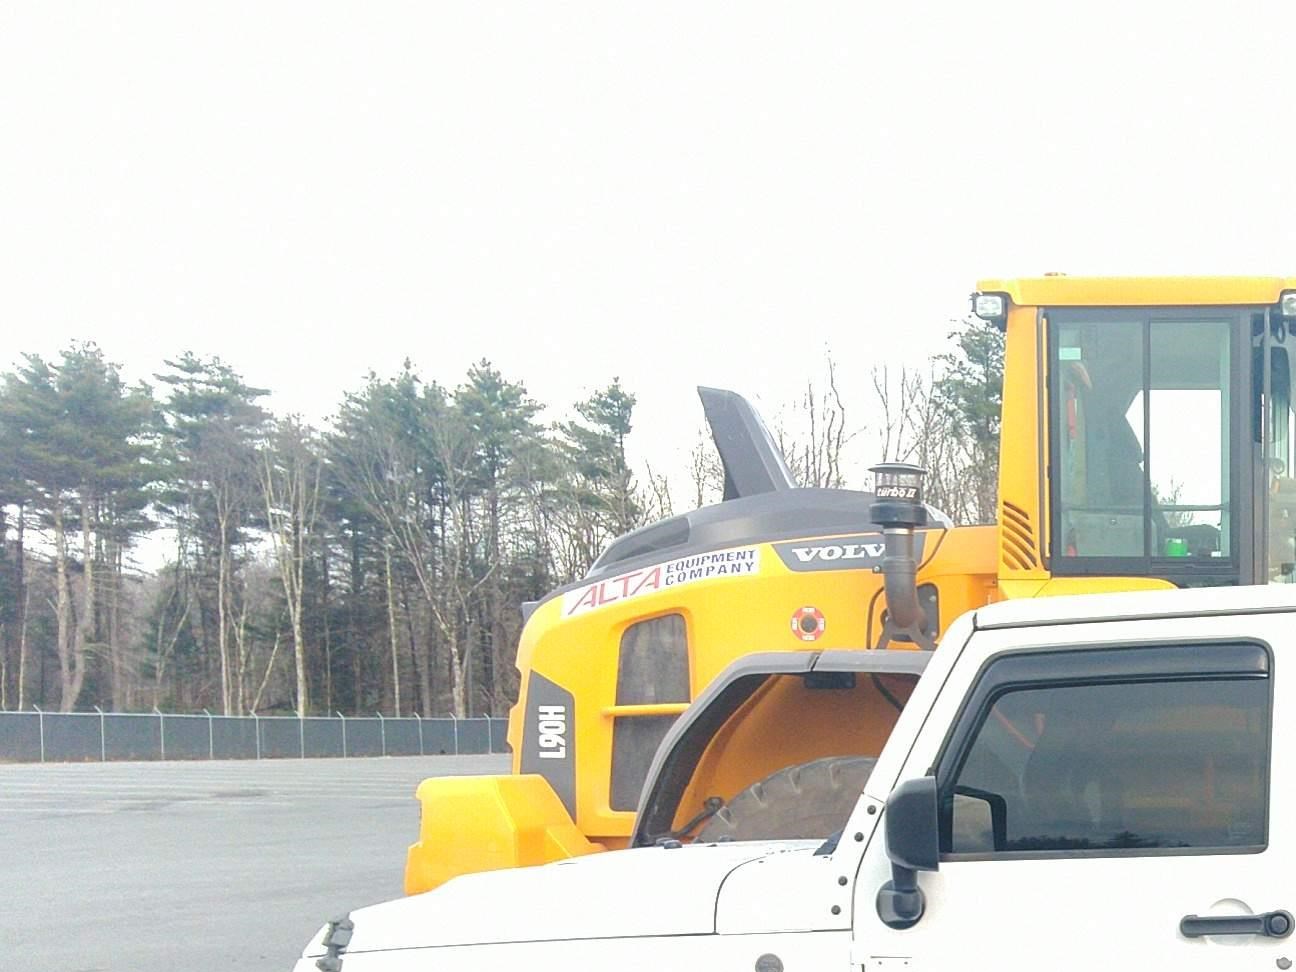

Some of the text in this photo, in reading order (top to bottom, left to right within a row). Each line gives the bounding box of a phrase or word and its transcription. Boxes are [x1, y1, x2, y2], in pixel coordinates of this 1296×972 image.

[666, 550, 757, 574] EQUIPMENT
[791, 543, 886, 562] VOLV
[665, 561, 756, 586] COMPANY
[567, 567, 661, 616] ALTA
[538, 705, 566, 759] L90H
